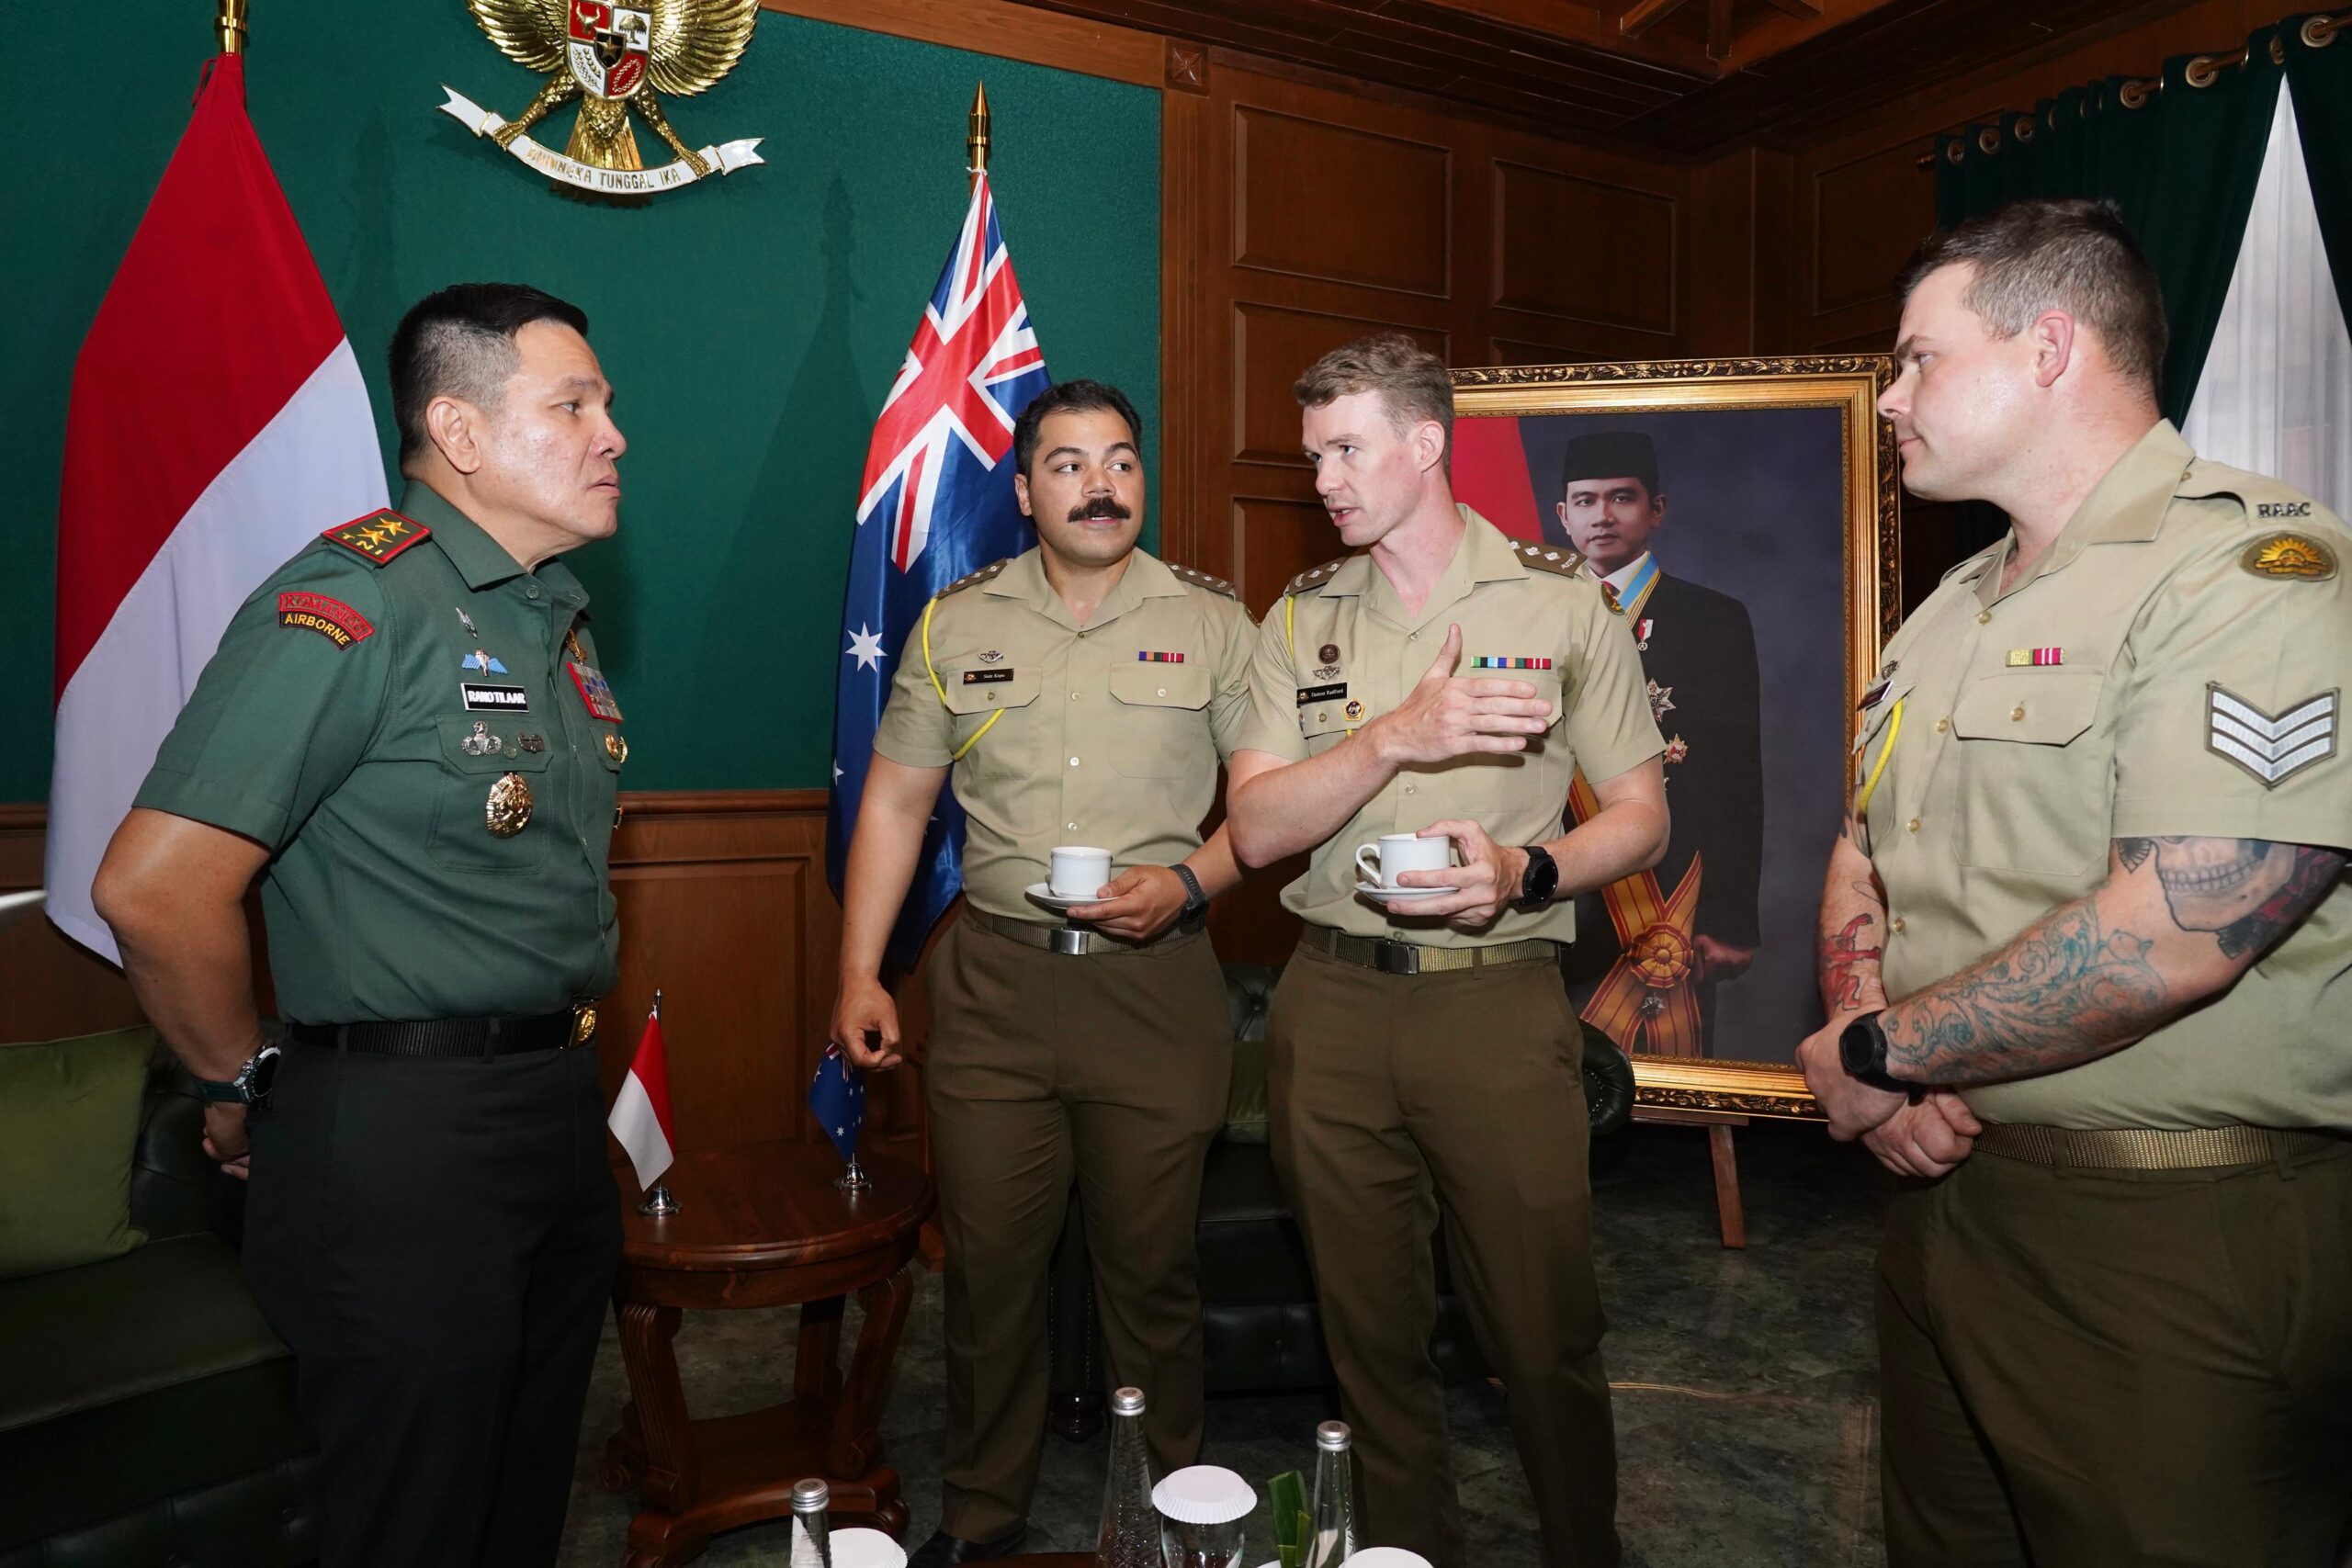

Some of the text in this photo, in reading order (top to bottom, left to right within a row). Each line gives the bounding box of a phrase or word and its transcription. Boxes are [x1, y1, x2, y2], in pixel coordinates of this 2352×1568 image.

[600, 172, 654, 188] TUNGGAL
[660, 168, 681, 185] IKA
[2257, 502, 2312, 518] RAAC
[285, 614, 350, 645] AIRBORNE
